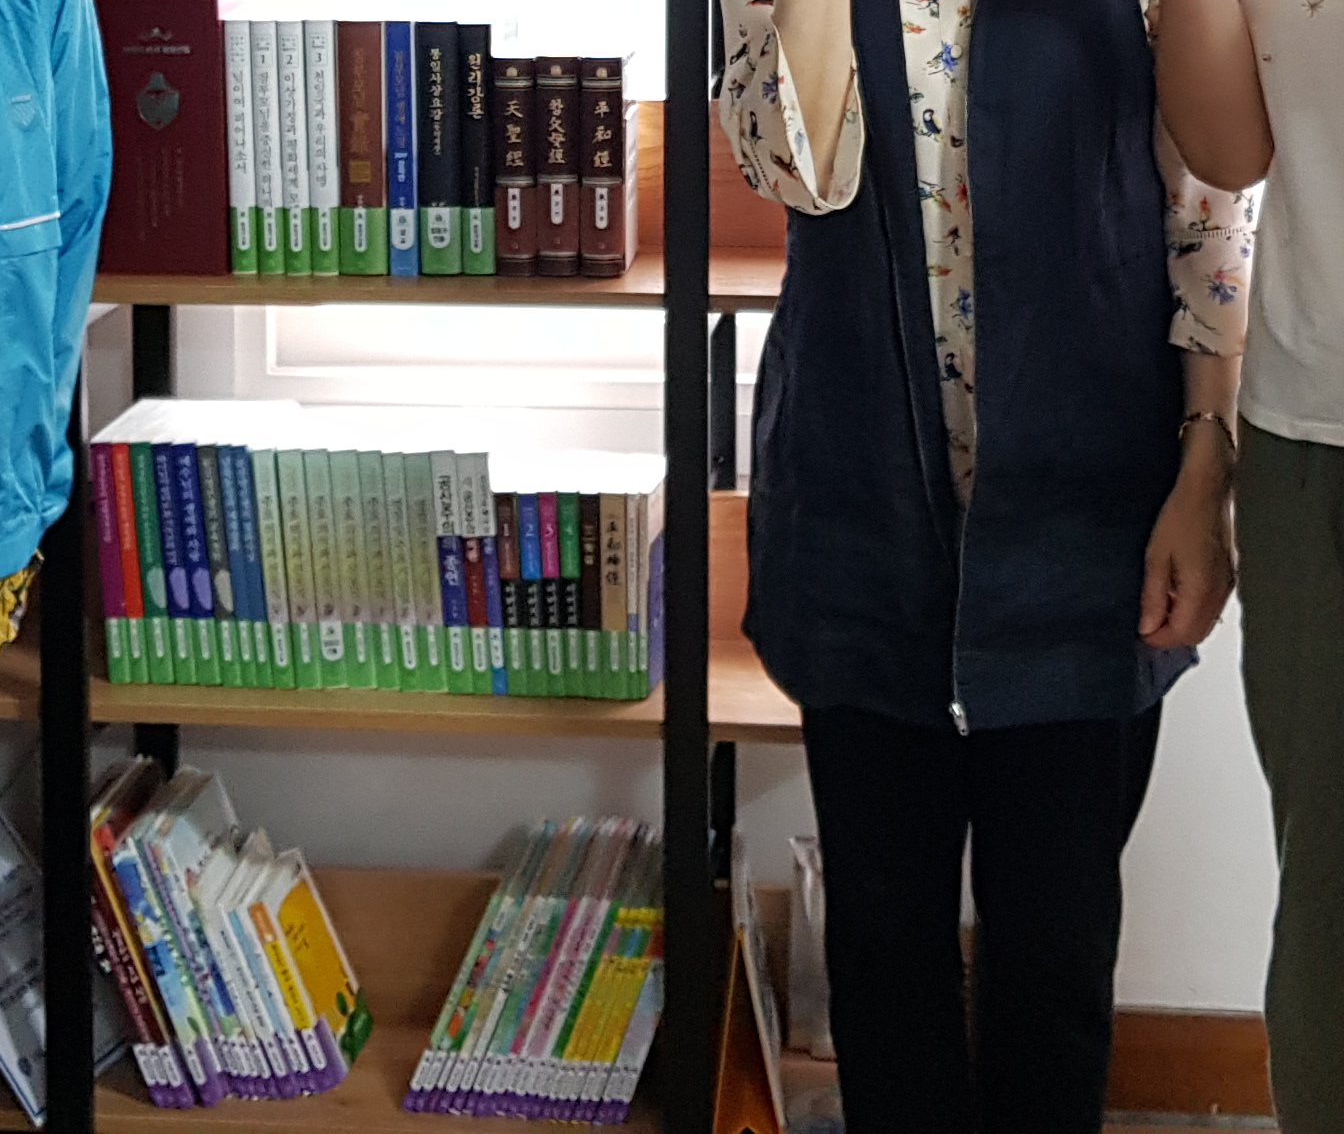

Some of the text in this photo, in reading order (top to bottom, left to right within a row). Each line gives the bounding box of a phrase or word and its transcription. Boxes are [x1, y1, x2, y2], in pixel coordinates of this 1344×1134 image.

[286, 54, 293, 65] 2
[315, 52, 322, 63] 3
[467, 53, 484, 120] 원리강론
[505, 100, 524, 167] 天聖經
[592, 100, 613, 168] 平和經
[525, 523, 535, 537] 2
